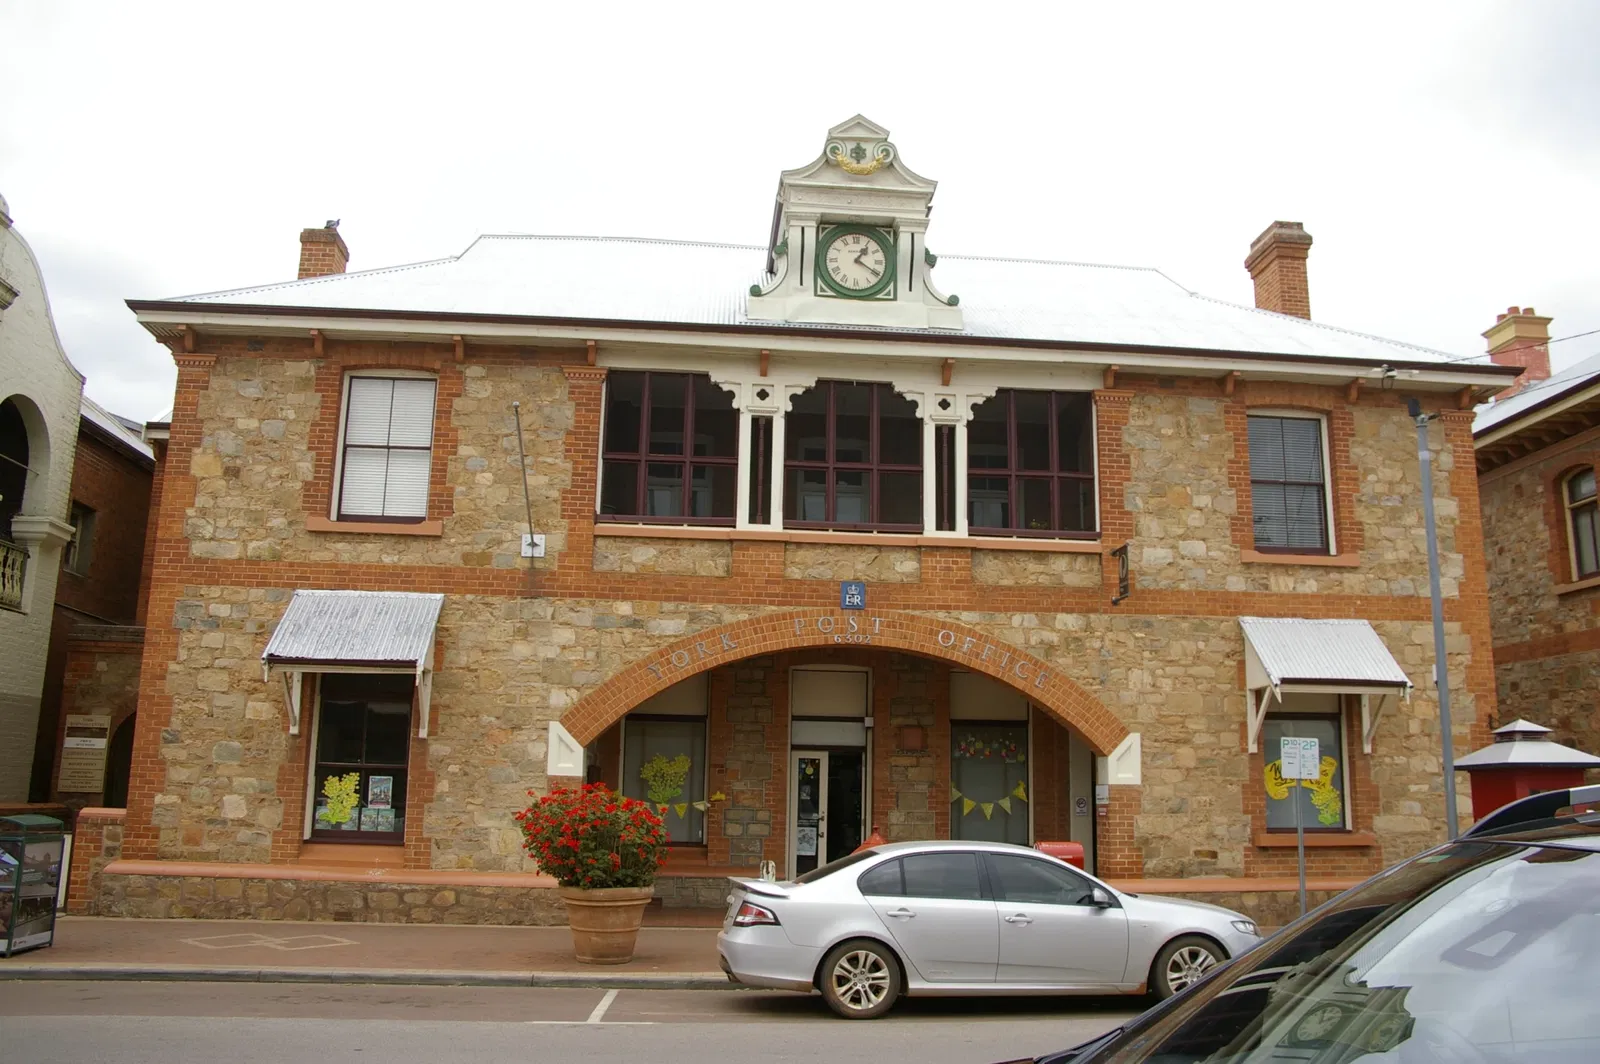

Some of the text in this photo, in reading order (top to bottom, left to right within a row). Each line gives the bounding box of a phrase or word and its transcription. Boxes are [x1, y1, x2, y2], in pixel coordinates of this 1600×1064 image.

[834, 634, 871, 644] 6302
[647, 616, 1049, 688] YORK POST OFFICE
[1302, 740, 1317, 751] 2P
